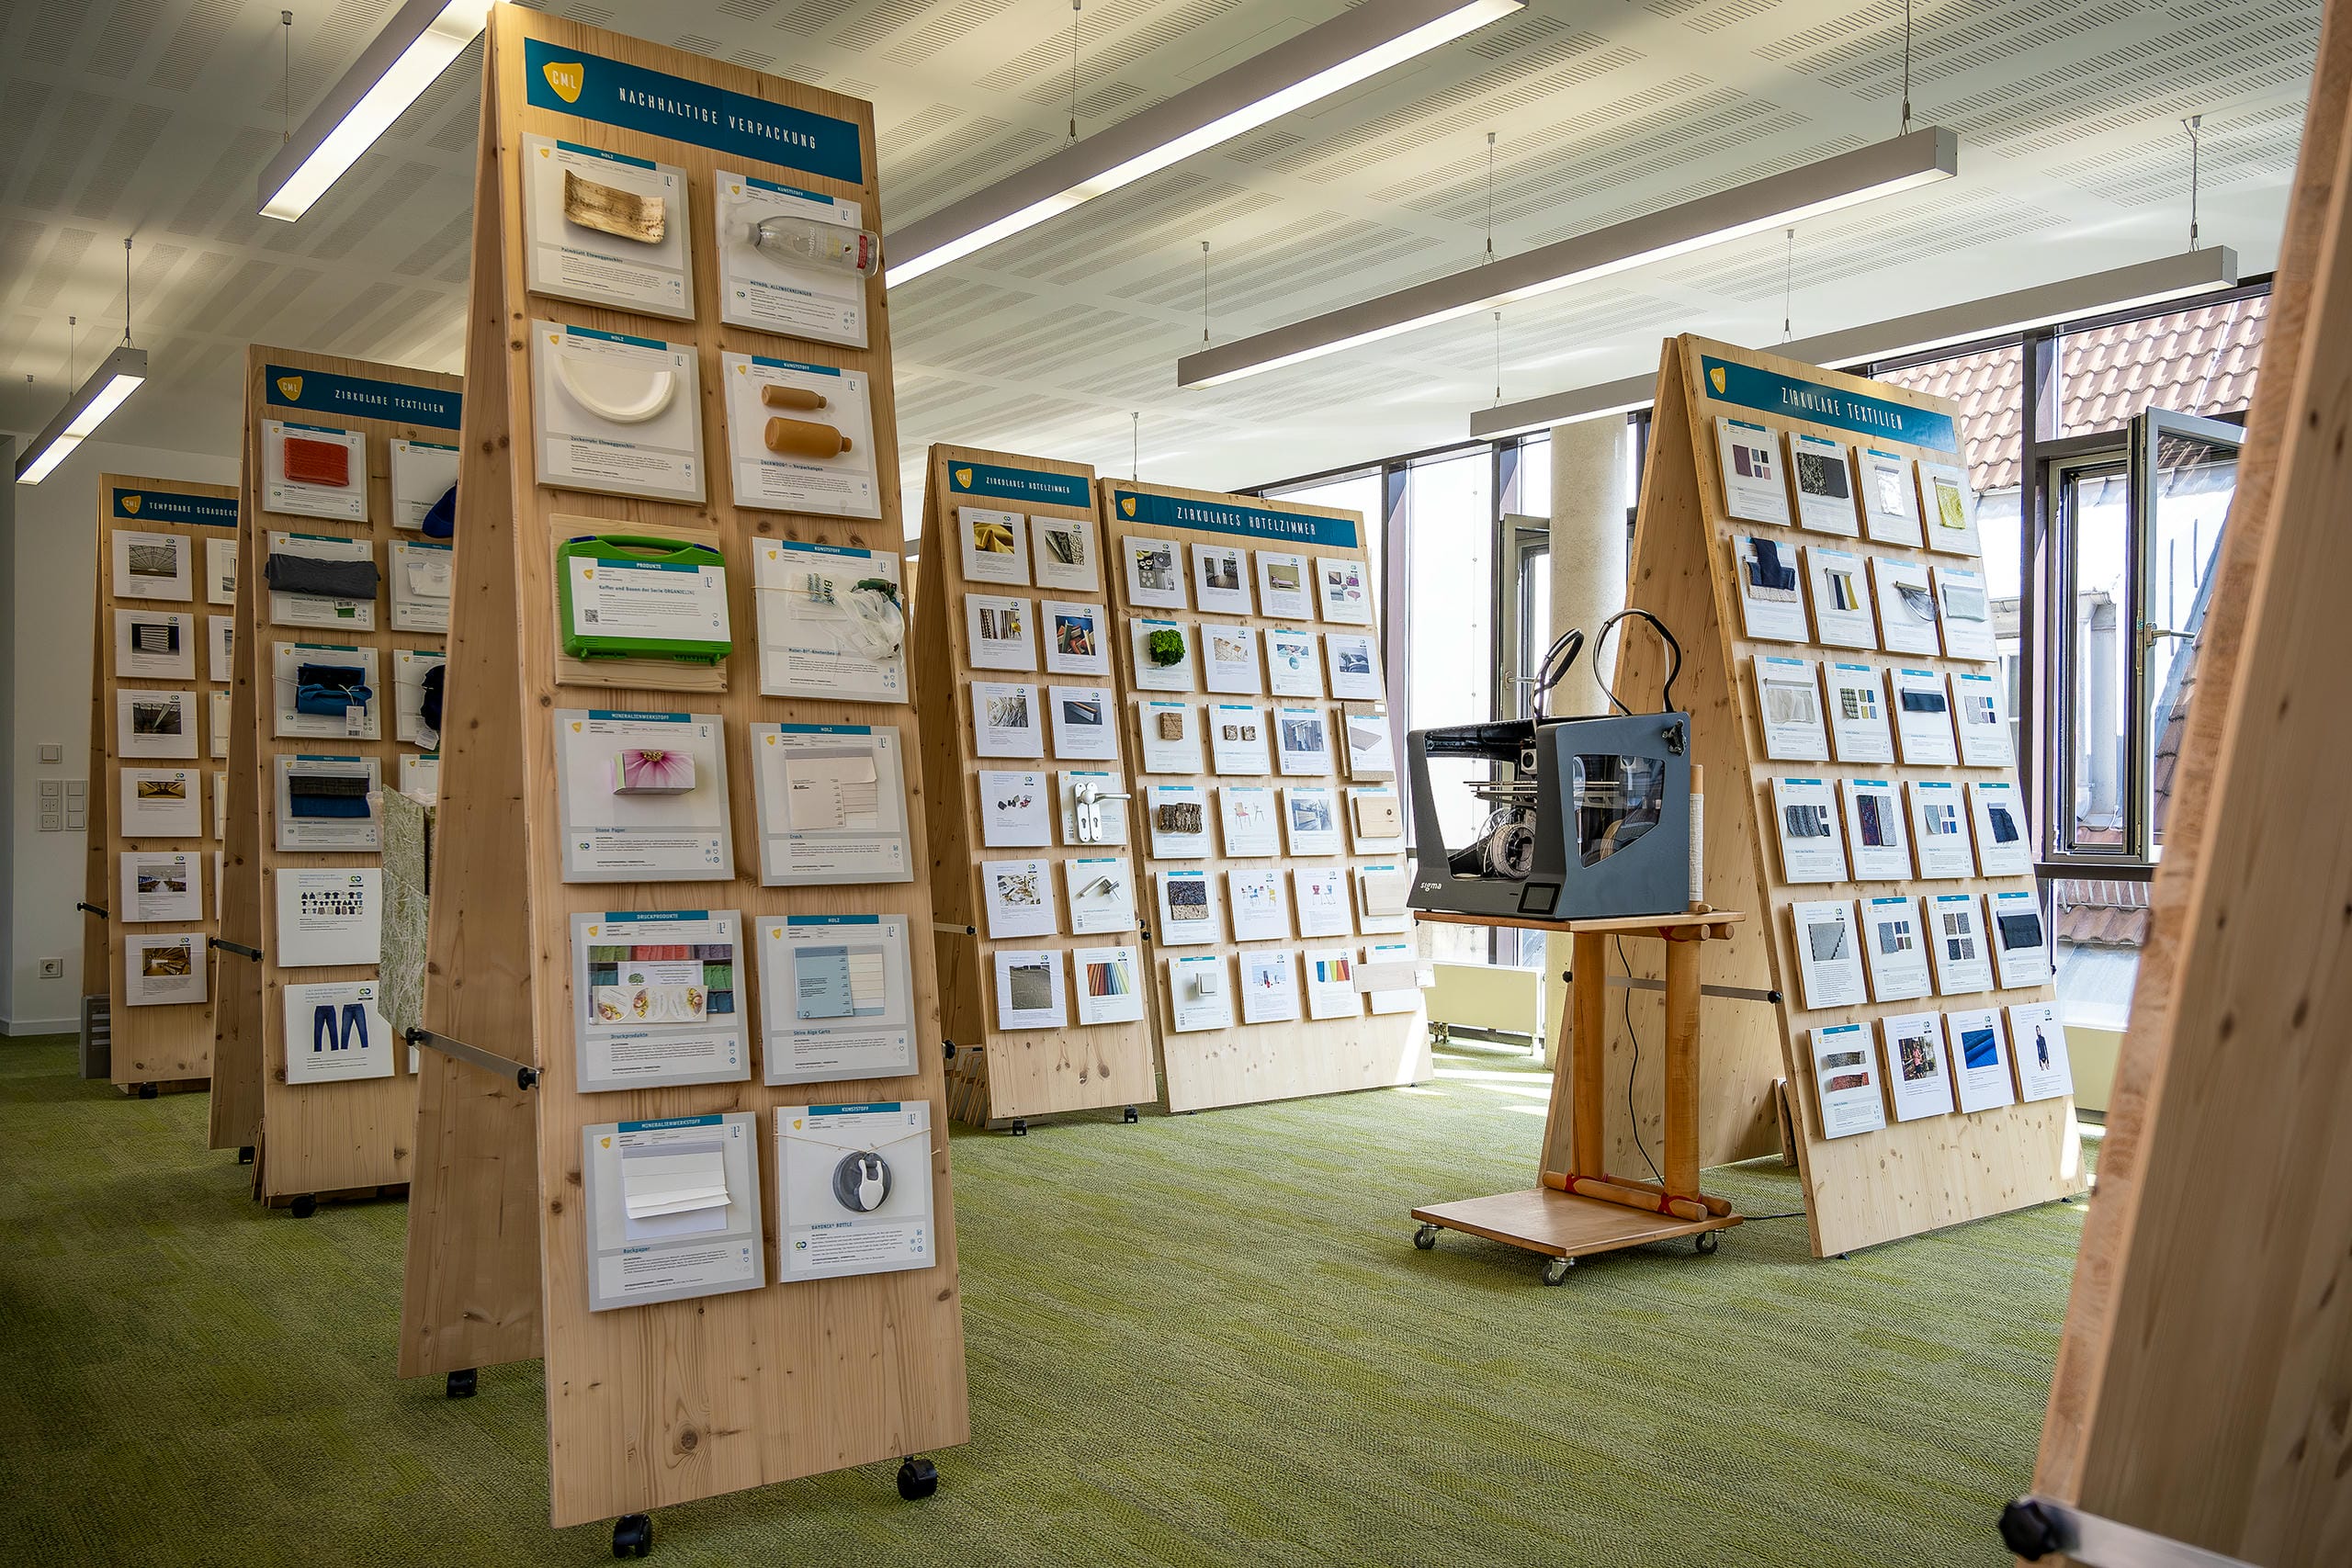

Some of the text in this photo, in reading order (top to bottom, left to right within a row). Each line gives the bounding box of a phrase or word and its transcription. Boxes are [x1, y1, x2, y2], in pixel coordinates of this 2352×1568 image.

[552, 70, 577, 89] CML
[619, 87, 816, 149] NACHHALTIGE VERPACKUNG
[394, 398, 445, 413] TEXTILIEN
[1847, 402, 1903, 431] TEXTILIEN
[1029, 482, 1070, 494] HOTELZIMMER
[1249, 515, 1316, 536] HOTELZIMMER
[1419, 882, 1442, 892] sigma
